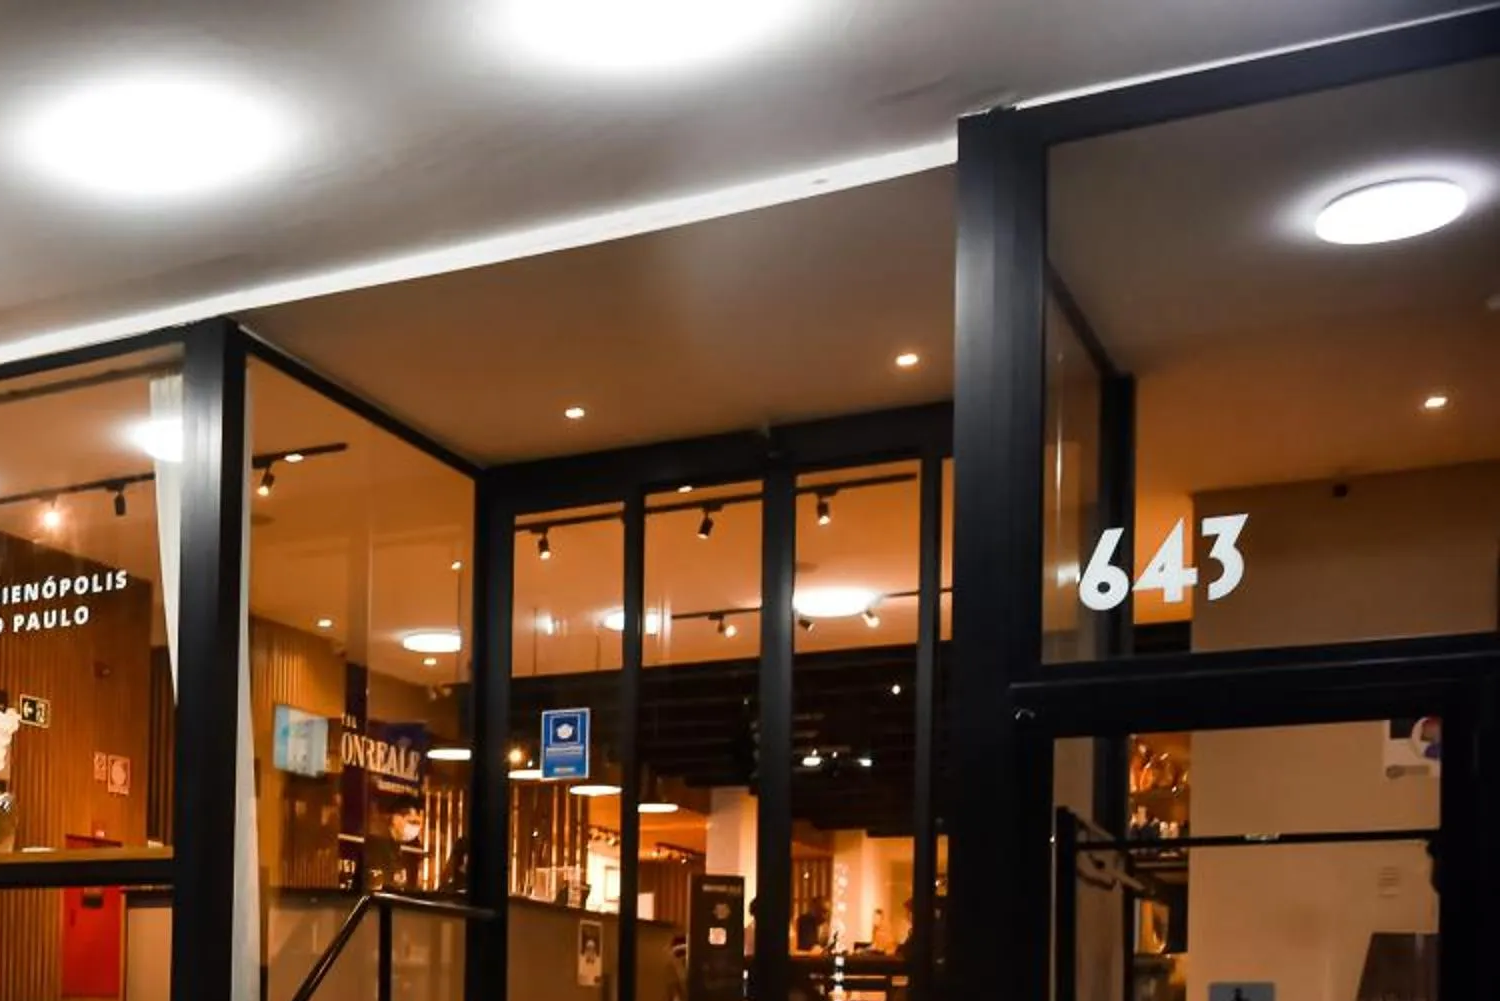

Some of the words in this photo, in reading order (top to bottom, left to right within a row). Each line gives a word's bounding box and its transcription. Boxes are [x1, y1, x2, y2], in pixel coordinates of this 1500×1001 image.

[1079, 513, 1249, 611] 643
[13, 605, 89, 632] PAULO
[341, 732, 419, 782] ONREALE
